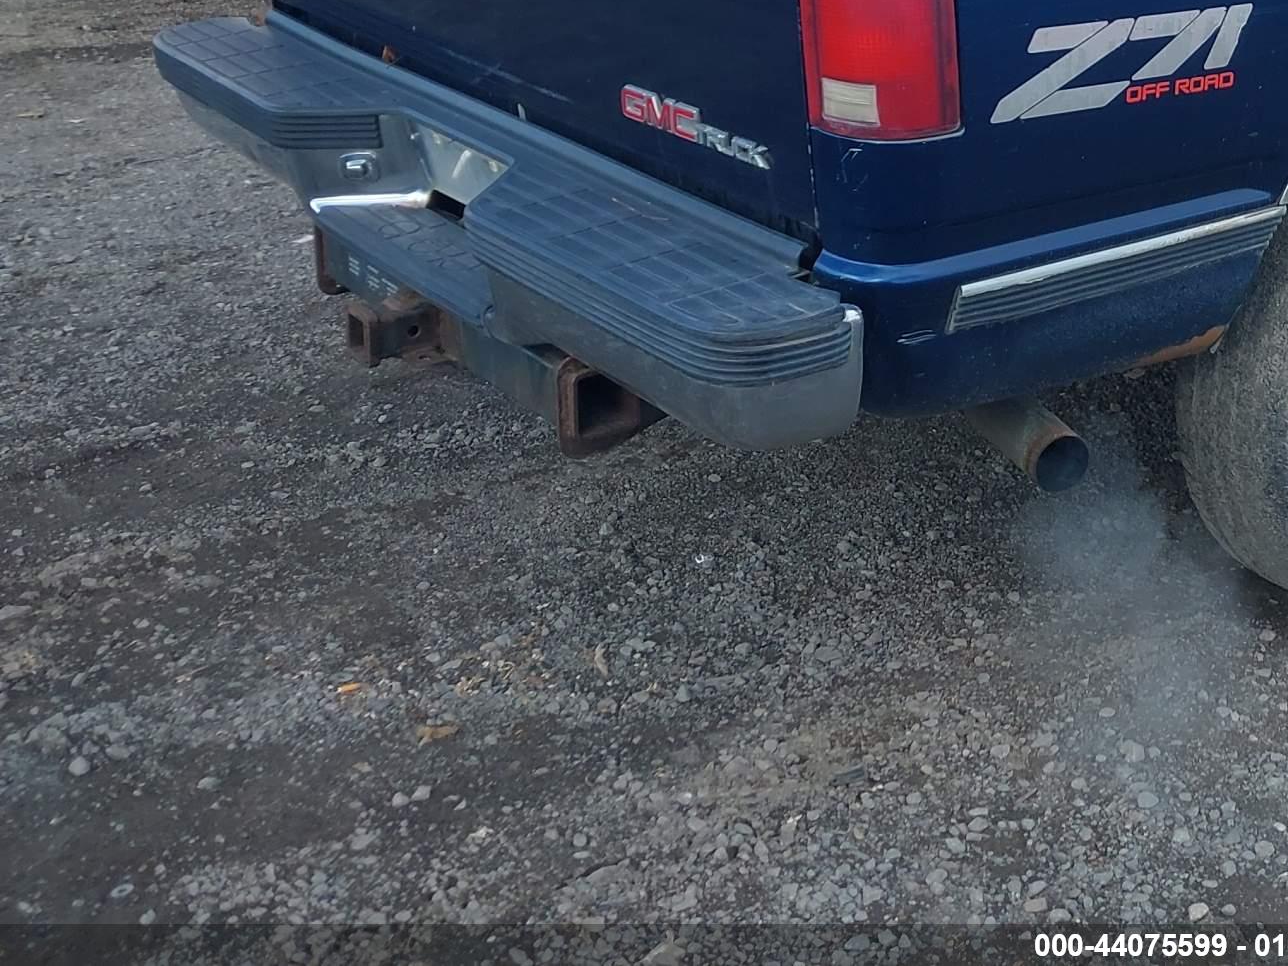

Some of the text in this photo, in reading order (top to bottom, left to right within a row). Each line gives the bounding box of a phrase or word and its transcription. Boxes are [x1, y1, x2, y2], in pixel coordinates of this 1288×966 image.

[989, 2, 1254, 125] Z71
[1125, 70, 1236, 104] OFF ROAD
[620, 83, 772, 170] GMC TRUCK
